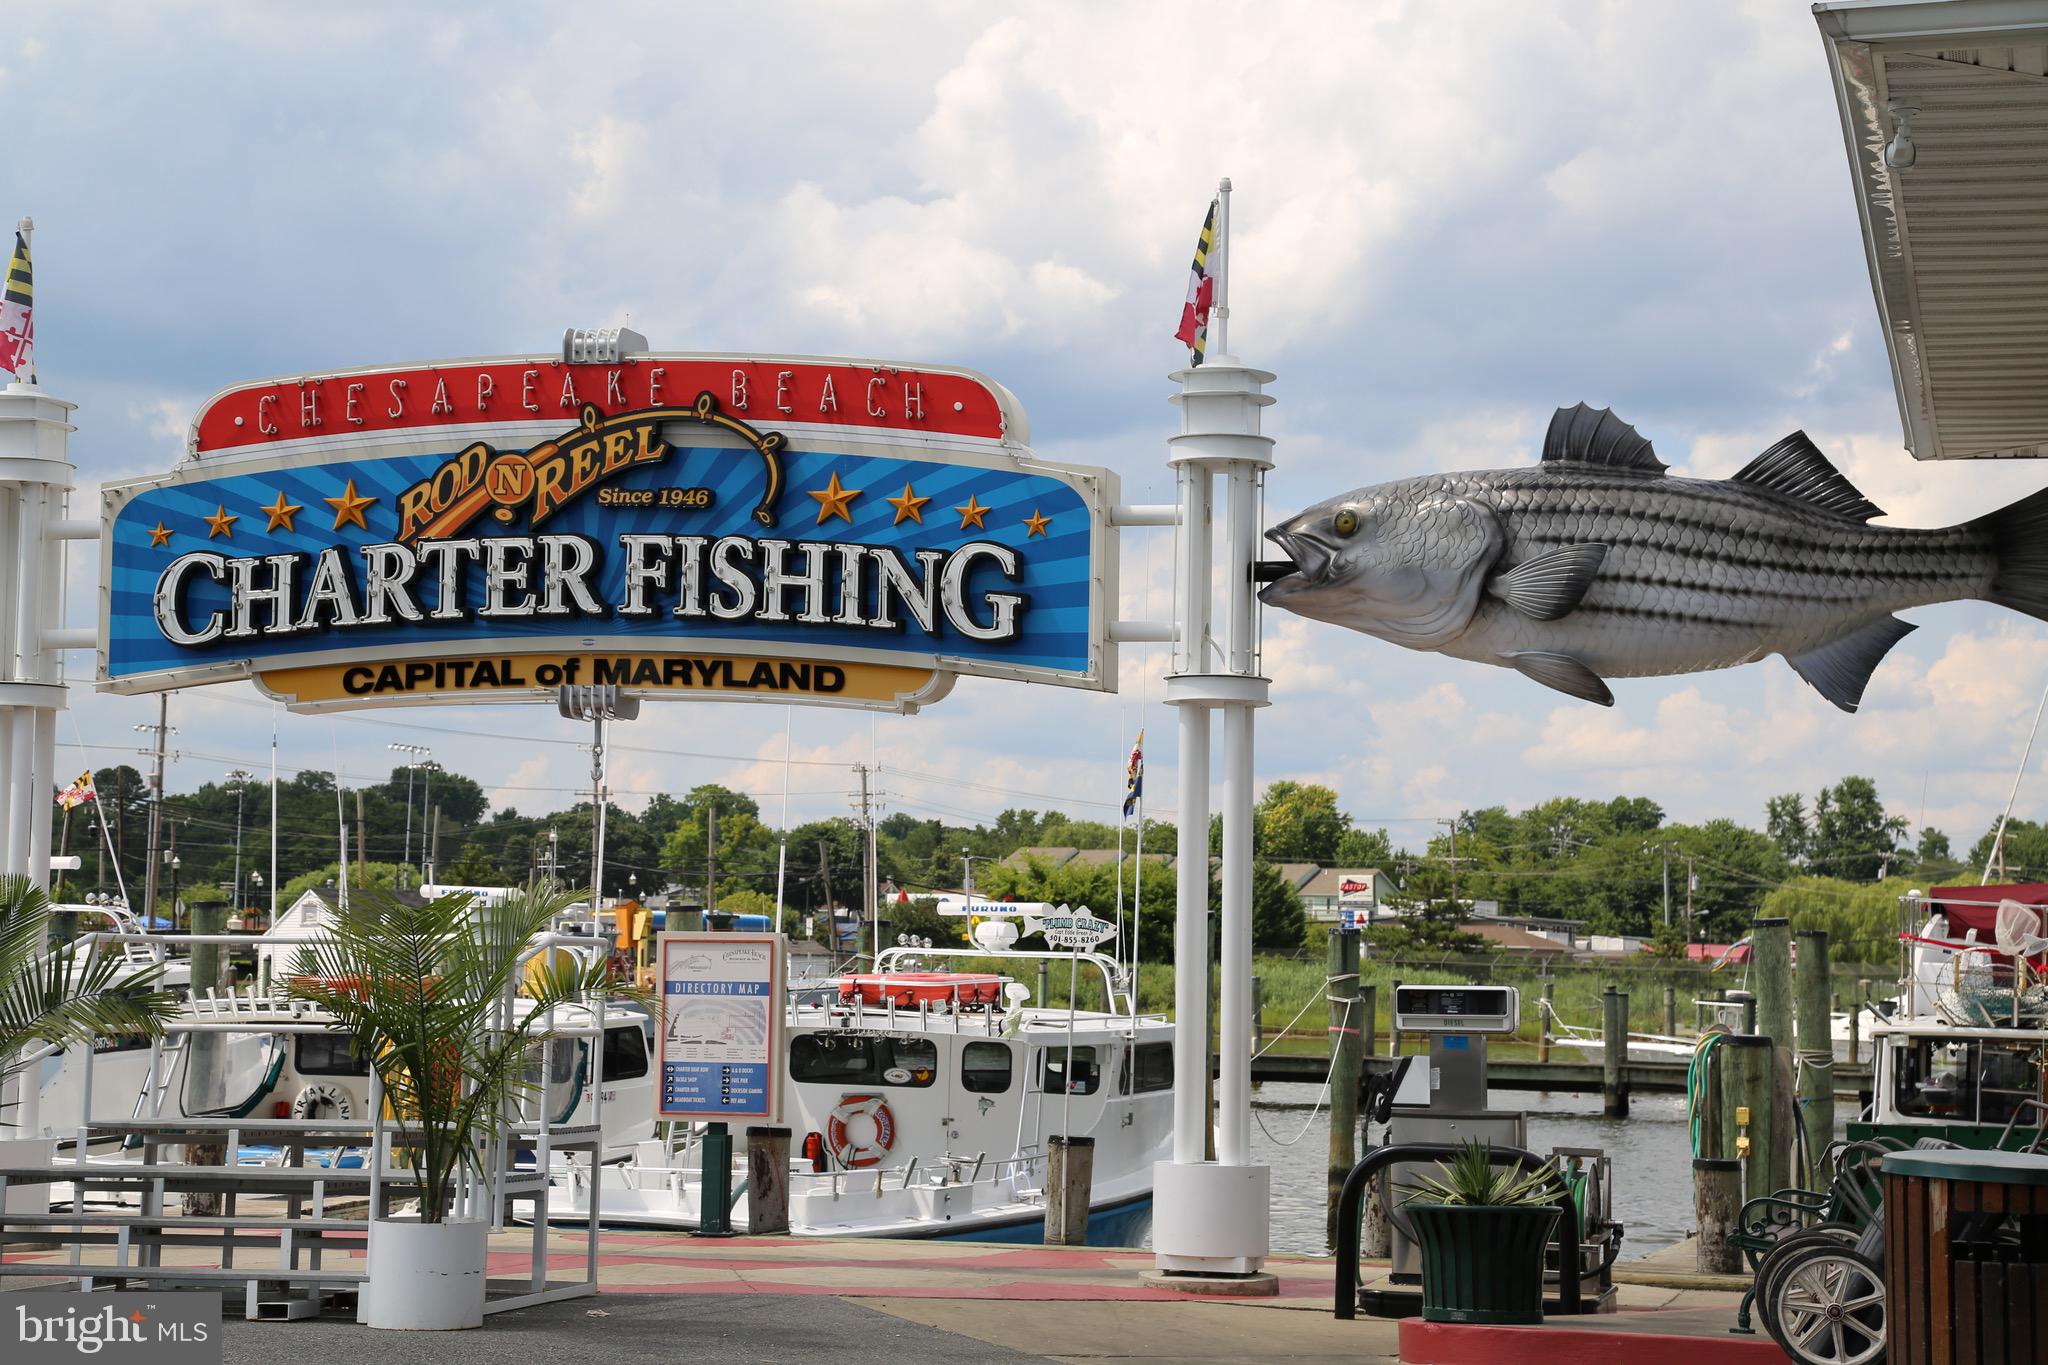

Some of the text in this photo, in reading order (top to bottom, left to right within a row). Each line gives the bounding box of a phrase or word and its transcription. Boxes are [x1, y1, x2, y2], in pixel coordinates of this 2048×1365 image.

[259, 368, 926, 434] CHESAPEAKE BEACH
[399, 426, 666, 541] ROD N REEL
[598, 488, 709, 505] Since 1946
[153, 534, 1022, 645] CHARTER FISHING
[343, 658, 846, 695] CAPITAL of MARYLAND
[1050, 935, 1100, 944] 301-855-8260
[675, 983, 760, 994] DIRECTORY MAP
[1443, 1019, 1464, 1027] DIESEL
